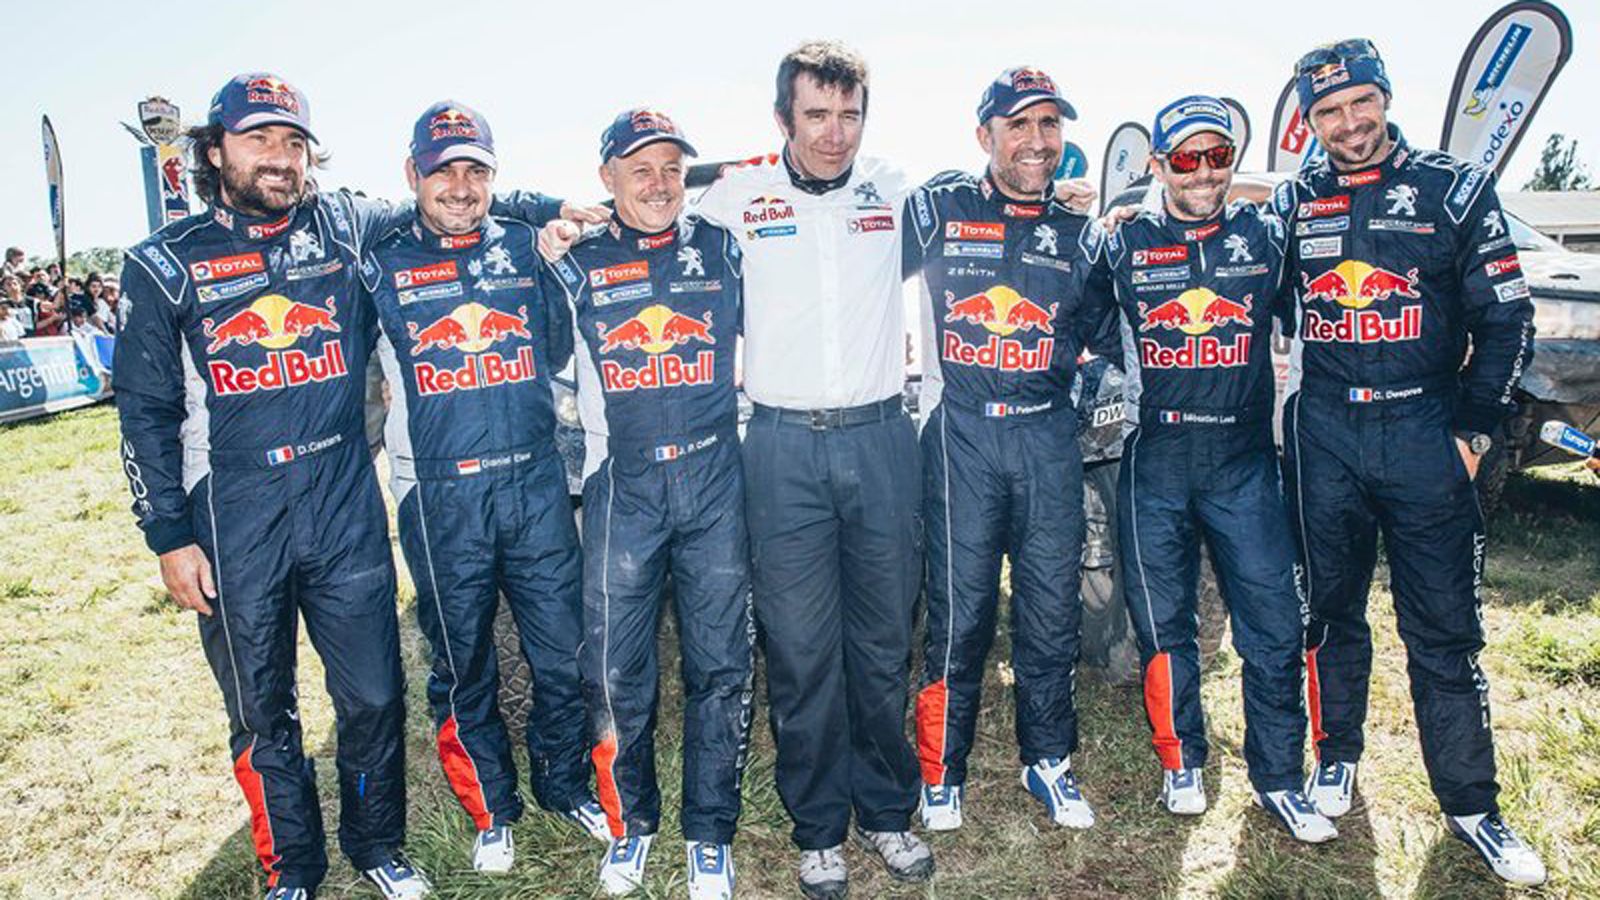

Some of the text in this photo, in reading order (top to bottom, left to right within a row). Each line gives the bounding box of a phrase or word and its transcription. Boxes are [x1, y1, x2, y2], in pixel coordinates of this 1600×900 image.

[1486, 27, 1523, 85] MICHELIN
[1480, 101, 1524, 166] odexo
[743, 206, 794, 224] Red Bull
[1313, 200, 1345, 212] TOTAL
[962, 226, 1001, 237] TOTAL
[213, 258, 262, 274] TOTAL
[1150, 249, 1186, 261] TOTAL
[414, 267, 456, 281] TOTAL
[607, 265, 643, 279] TOTAL
[948, 266, 996, 277] ZENITH
[1304, 305, 1422, 342] Red Bull
[943, 330, 999, 368] Red
[1001, 337, 1054, 372] Bull
[1140, 337, 1195, 368] Red
[1199, 333, 1251, 368] Bull
[208, 340, 347, 396] Red Bull
[414, 346, 536, 396] Red Bull
[601, 351, 714, 392] Red Bull
